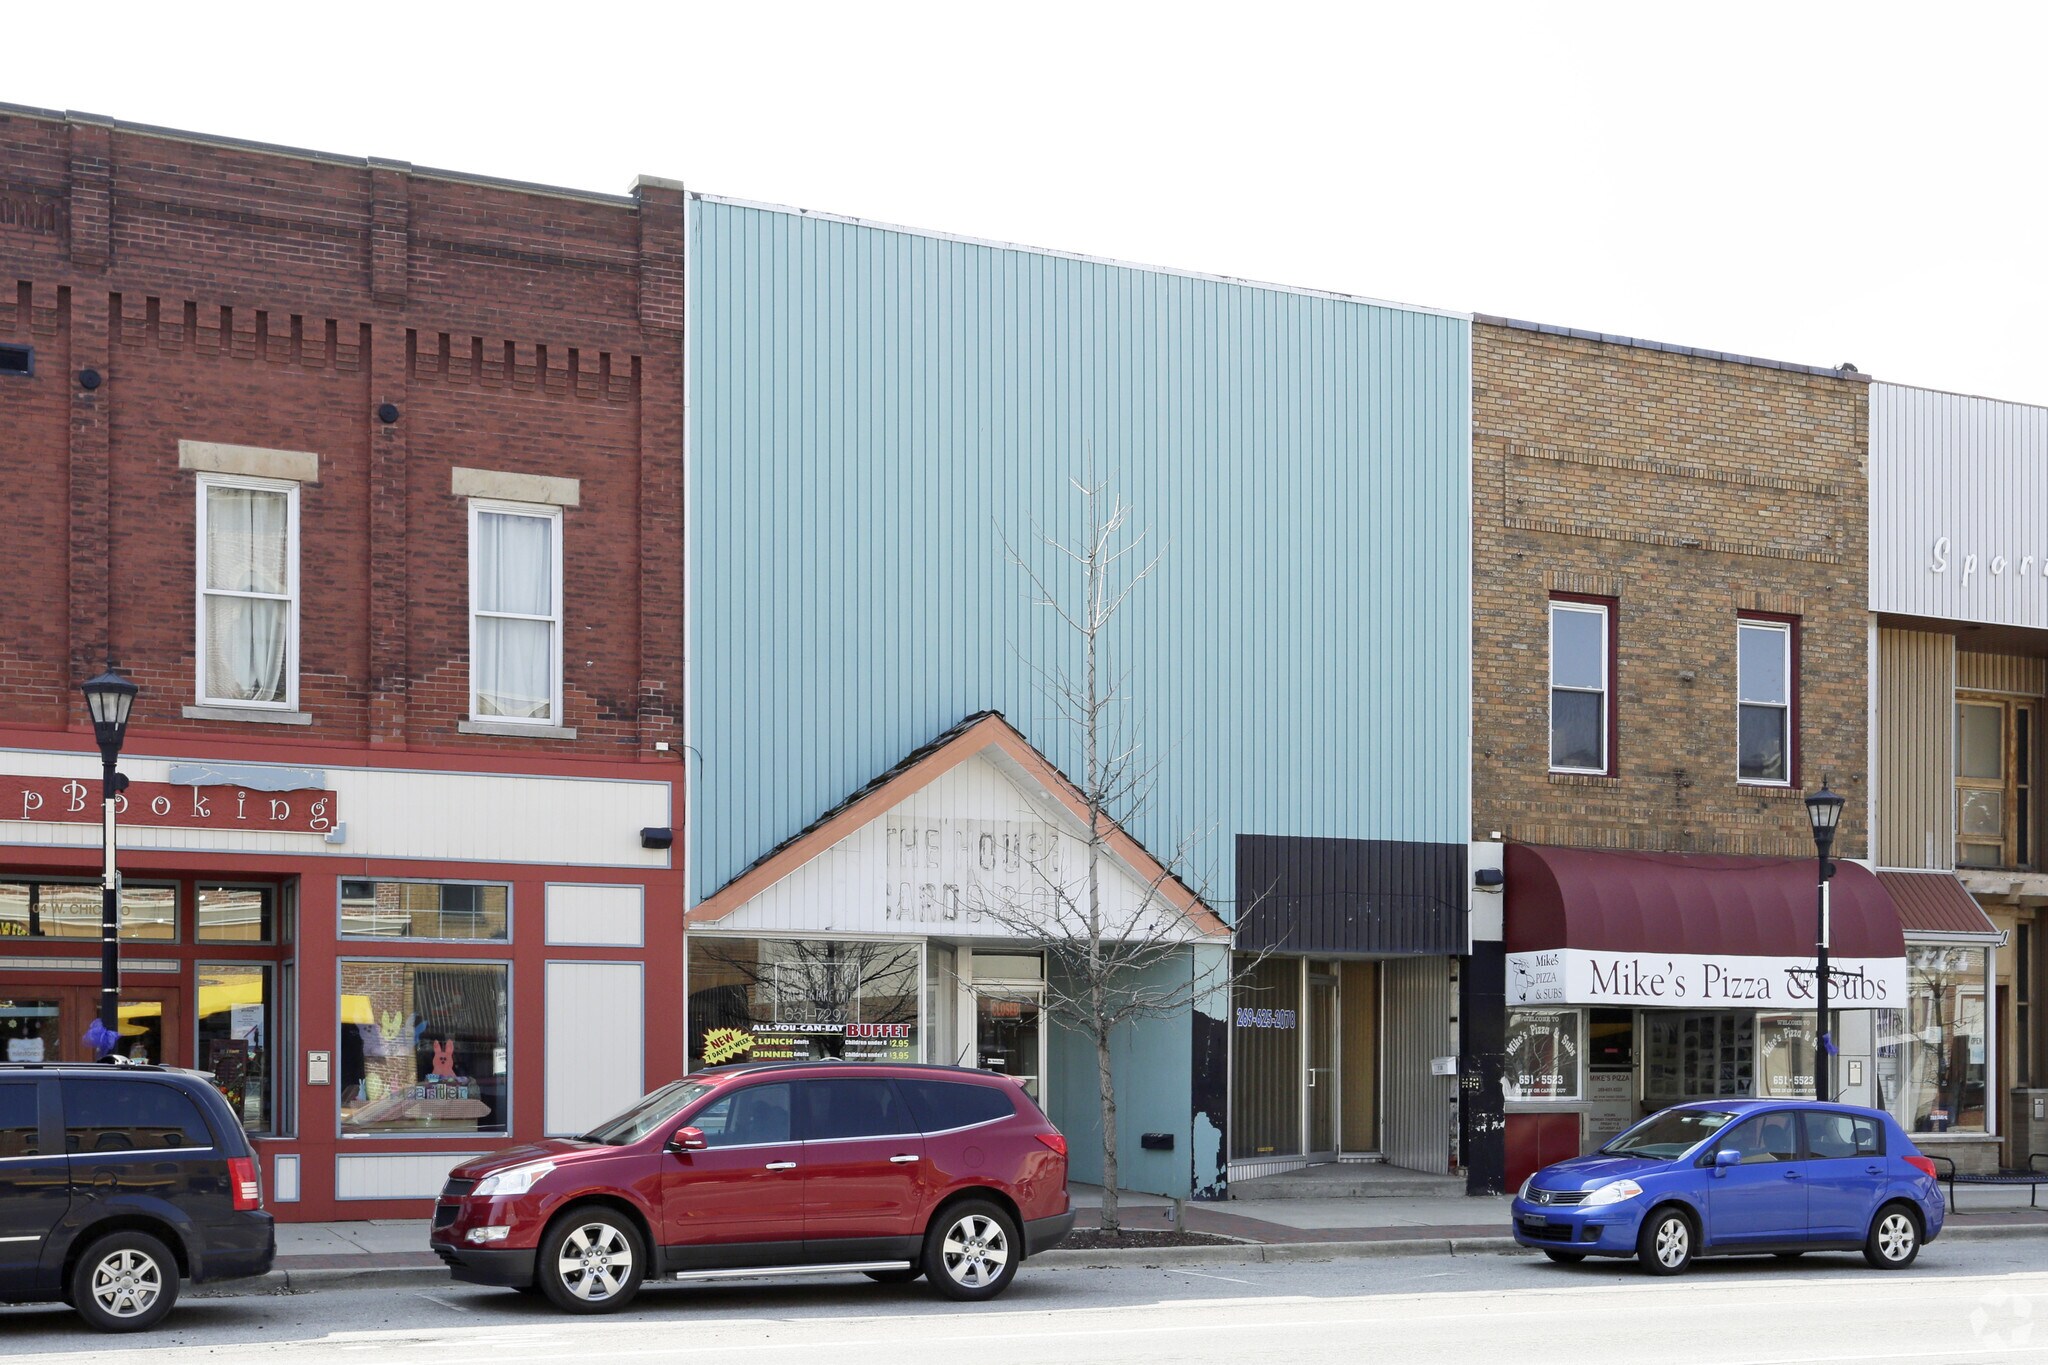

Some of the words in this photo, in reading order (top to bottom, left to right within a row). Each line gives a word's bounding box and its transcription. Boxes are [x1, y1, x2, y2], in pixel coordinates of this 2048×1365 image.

[70, 904, 130, 916] CHICO
[1535, 953, 1559, 967] Mike's
[1535, 972, 1557, 984] PIZZA
[1589, 959, 1686, 998] Mike's
[1702, 963, 1771, 1000] Pizza
[1786, 965, 1815, 999] &
[1827, 965, 1887, 1001] Subs
[1535, 988, 1543, 1000] &
[1544, 988, 1562, 1000] SUBS
[992, 1002, 1019, 1017] CLOSED
[1237, 1007, 1296, 1029] 269-625-2078
[752, 1024, 844, 1032] ALL-YOU-CAN-EAT
[846, 1024, 910, 1037] BUFFET
[710, 1032, 734, 1050] NEW
[712, 1048, 728, 1058] DAYS
[734, 1037, 751, 1048] WEEK
[1506, 1031, 1527, 1056] Mike's
[1530, 1024, 1550, 1036] Pizza
[1553, 1027, 1559, 1038] &
[1561, 1034, 1576, 1057] Subs
[1761, 1034, 1781, 1057] Mike's
[1783, 1027, 1802, 1038] Pizza
[1804, 1031, 1810, 1041] &
[1970, 1037, 1983, 1045] OPEN
[1590, 1074, 1610, 1082] MIKE'S
[1612, 1074, 1630, 1082] PIZZA
